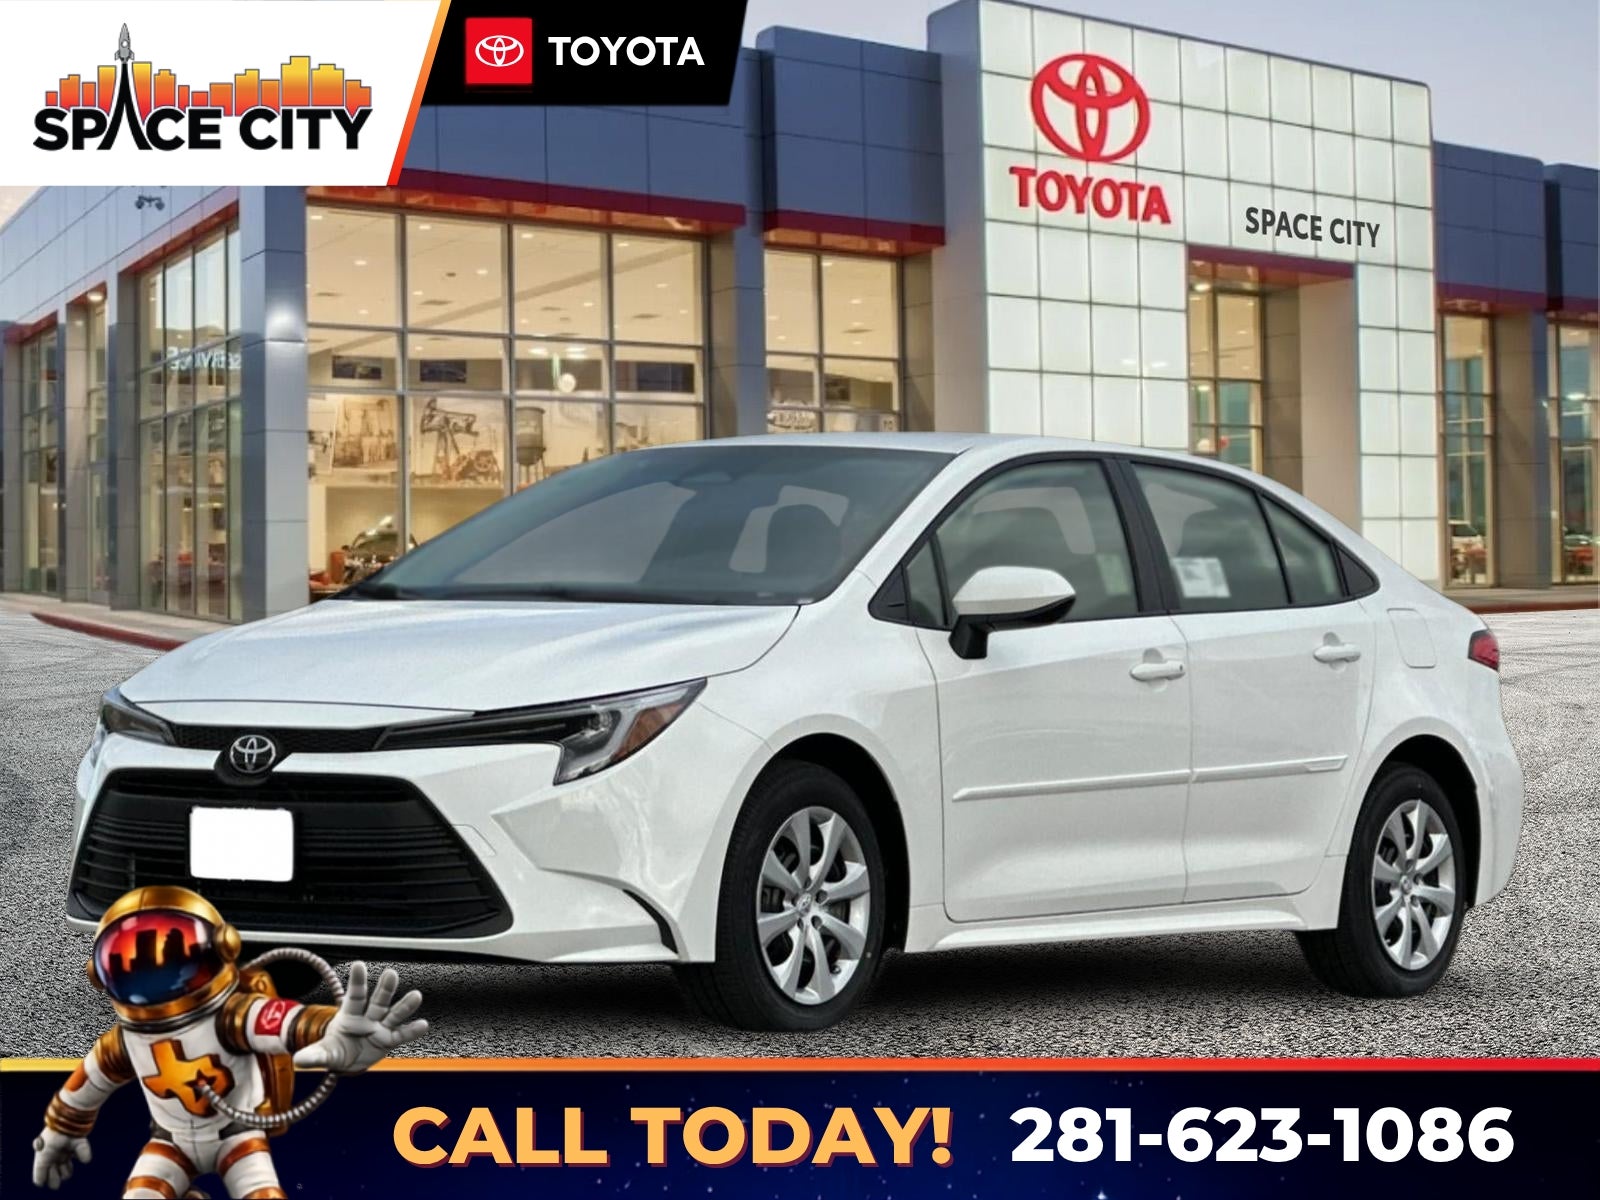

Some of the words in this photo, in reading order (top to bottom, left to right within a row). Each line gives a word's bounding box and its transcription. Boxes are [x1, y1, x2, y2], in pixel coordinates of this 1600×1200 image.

[1009, 165, 1171, 225] TOYOTA
[1245, 206, 1323, 242] SPACE
[1329, 217, 1381, 248] CITY
